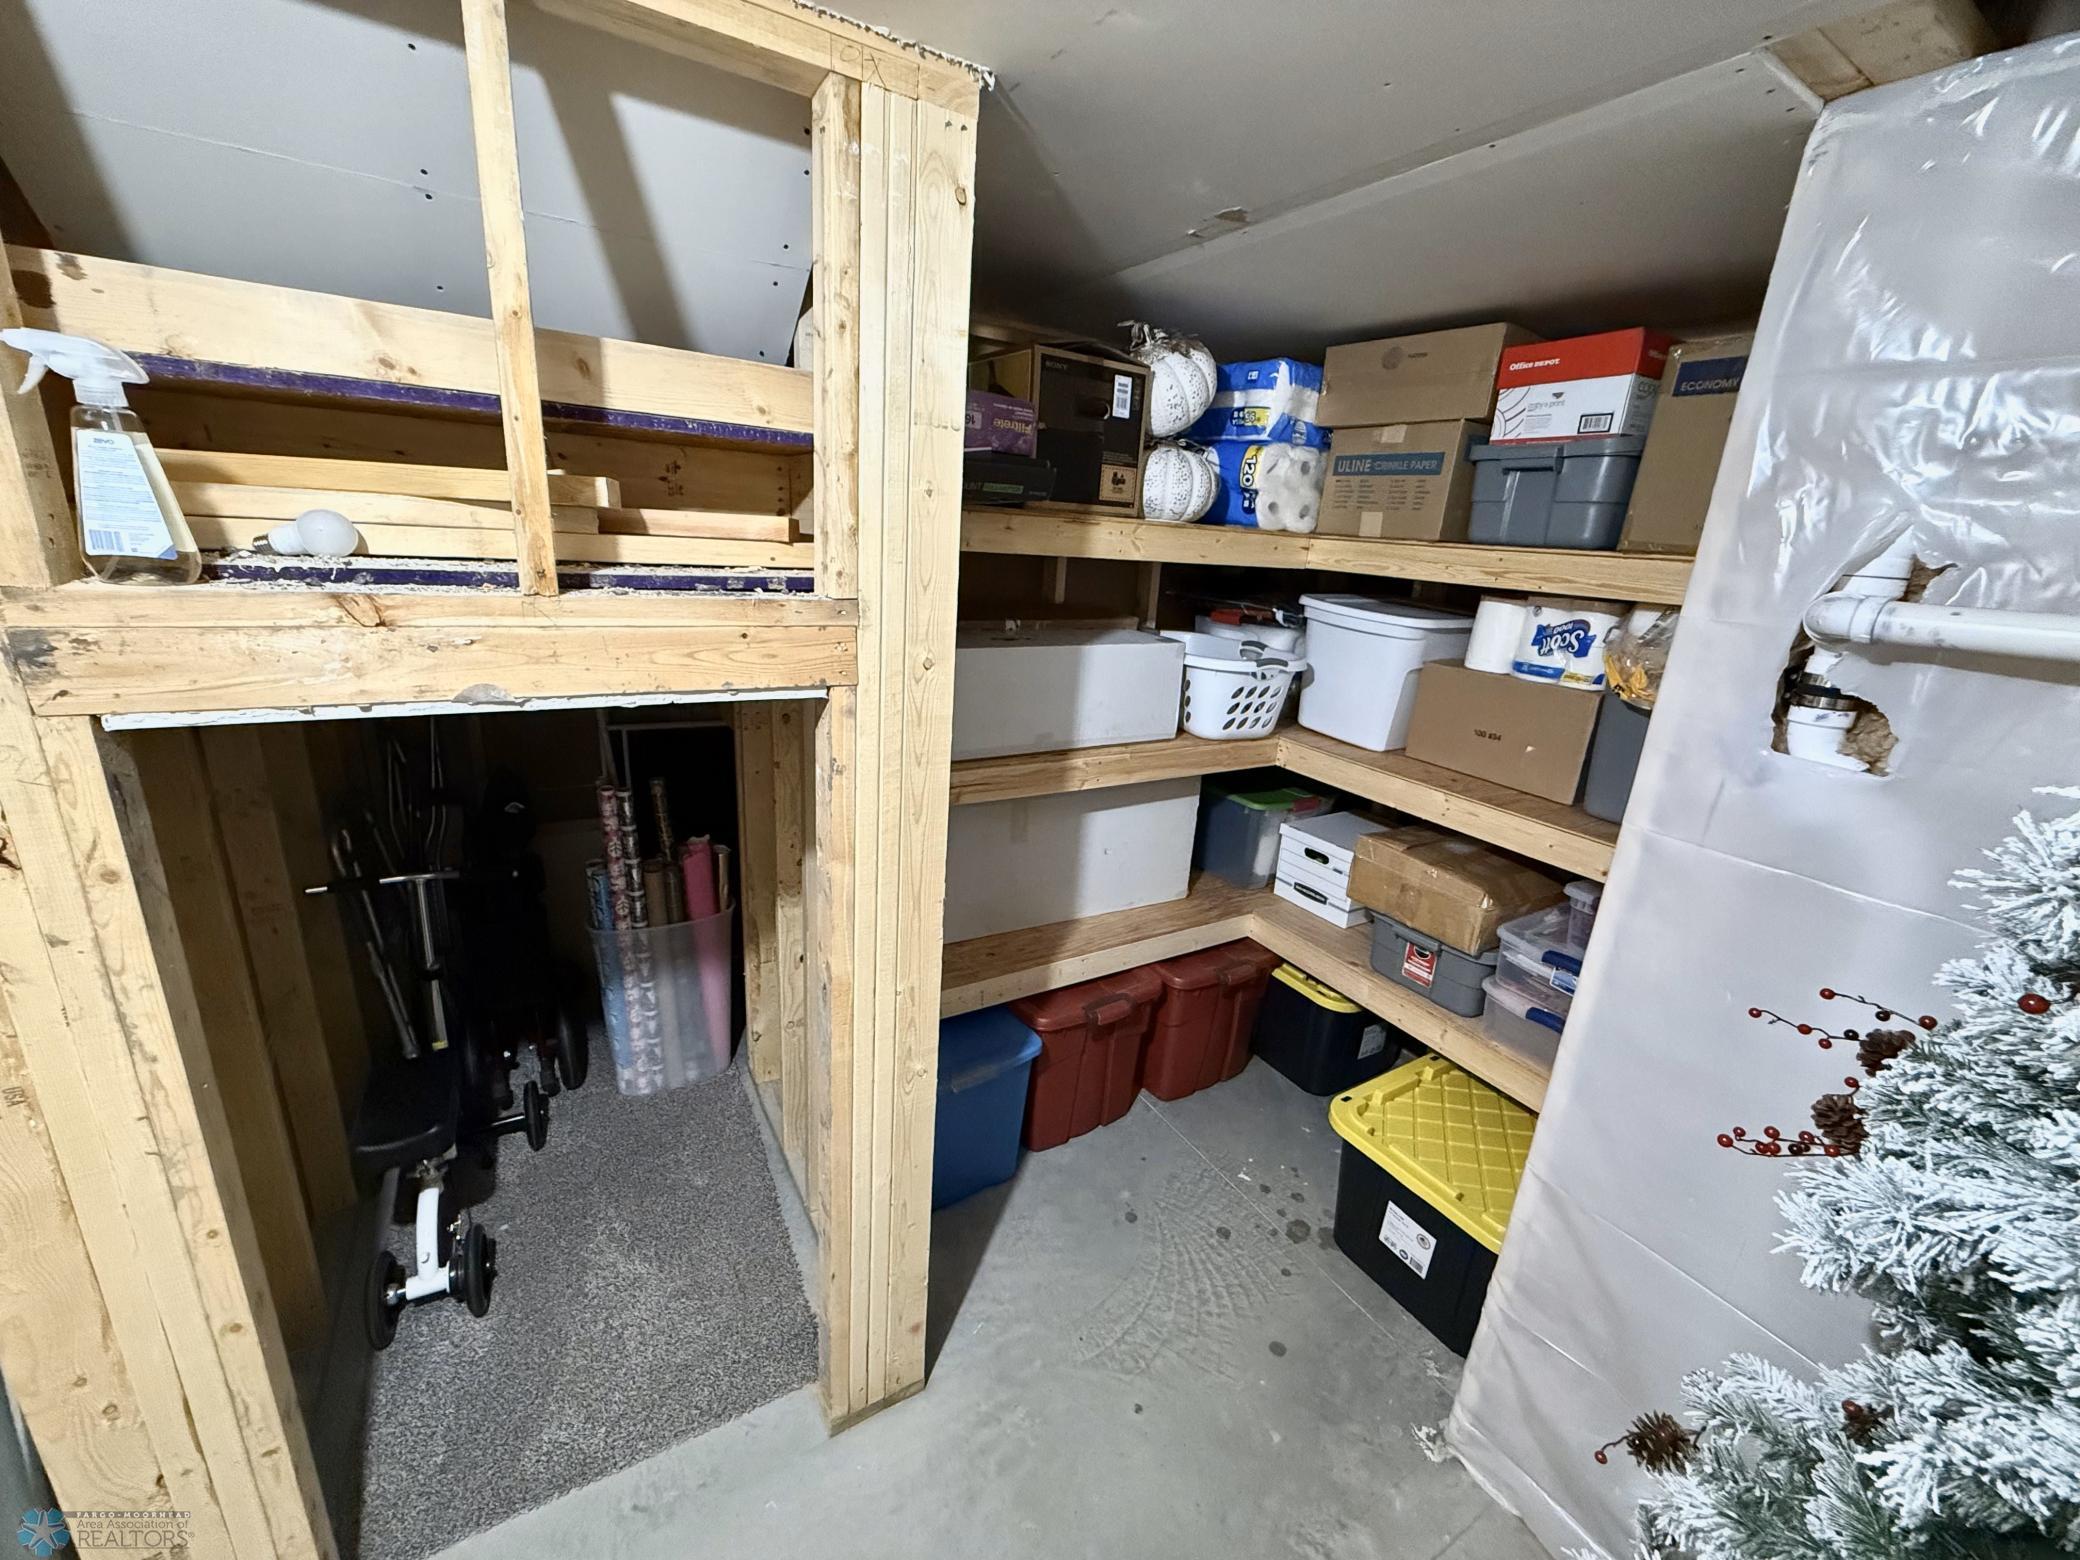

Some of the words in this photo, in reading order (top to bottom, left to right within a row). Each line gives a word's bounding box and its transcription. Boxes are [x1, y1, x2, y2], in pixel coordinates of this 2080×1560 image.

[1509, 362, 1533, 371] Office
[1534, 358, 1560, 368] DEPOT
[1681, 378, 1739, 391] ECONOMY
[993, 417, 1034, 436] Filtrete
[1242, 456, 1258, 487] 120
[1338, 459, 1371, 472] ULINE
[1409, 459, 1438, 470] PAPER
[1540, 629, 1584, 655] Scott
